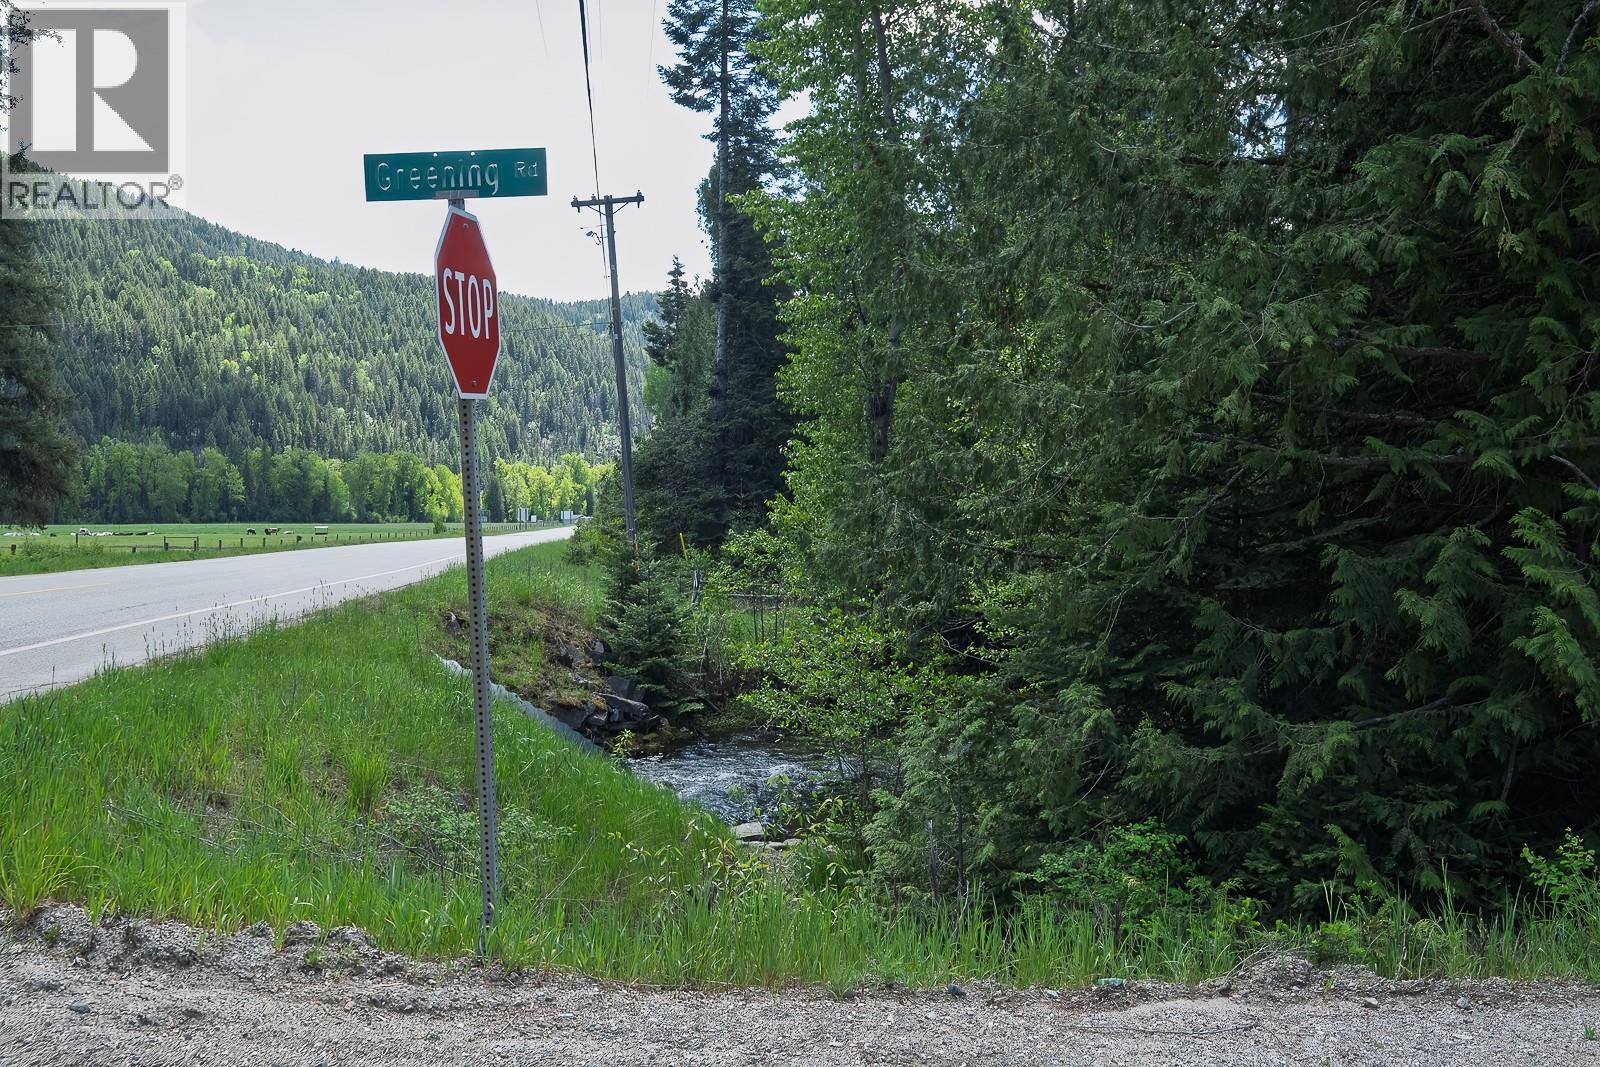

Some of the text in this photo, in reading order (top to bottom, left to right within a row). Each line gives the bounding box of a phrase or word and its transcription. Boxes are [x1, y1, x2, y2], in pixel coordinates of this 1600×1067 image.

[377, 159, 539, 195] Greening Rd
[443, 267, 494, 339] STOP
